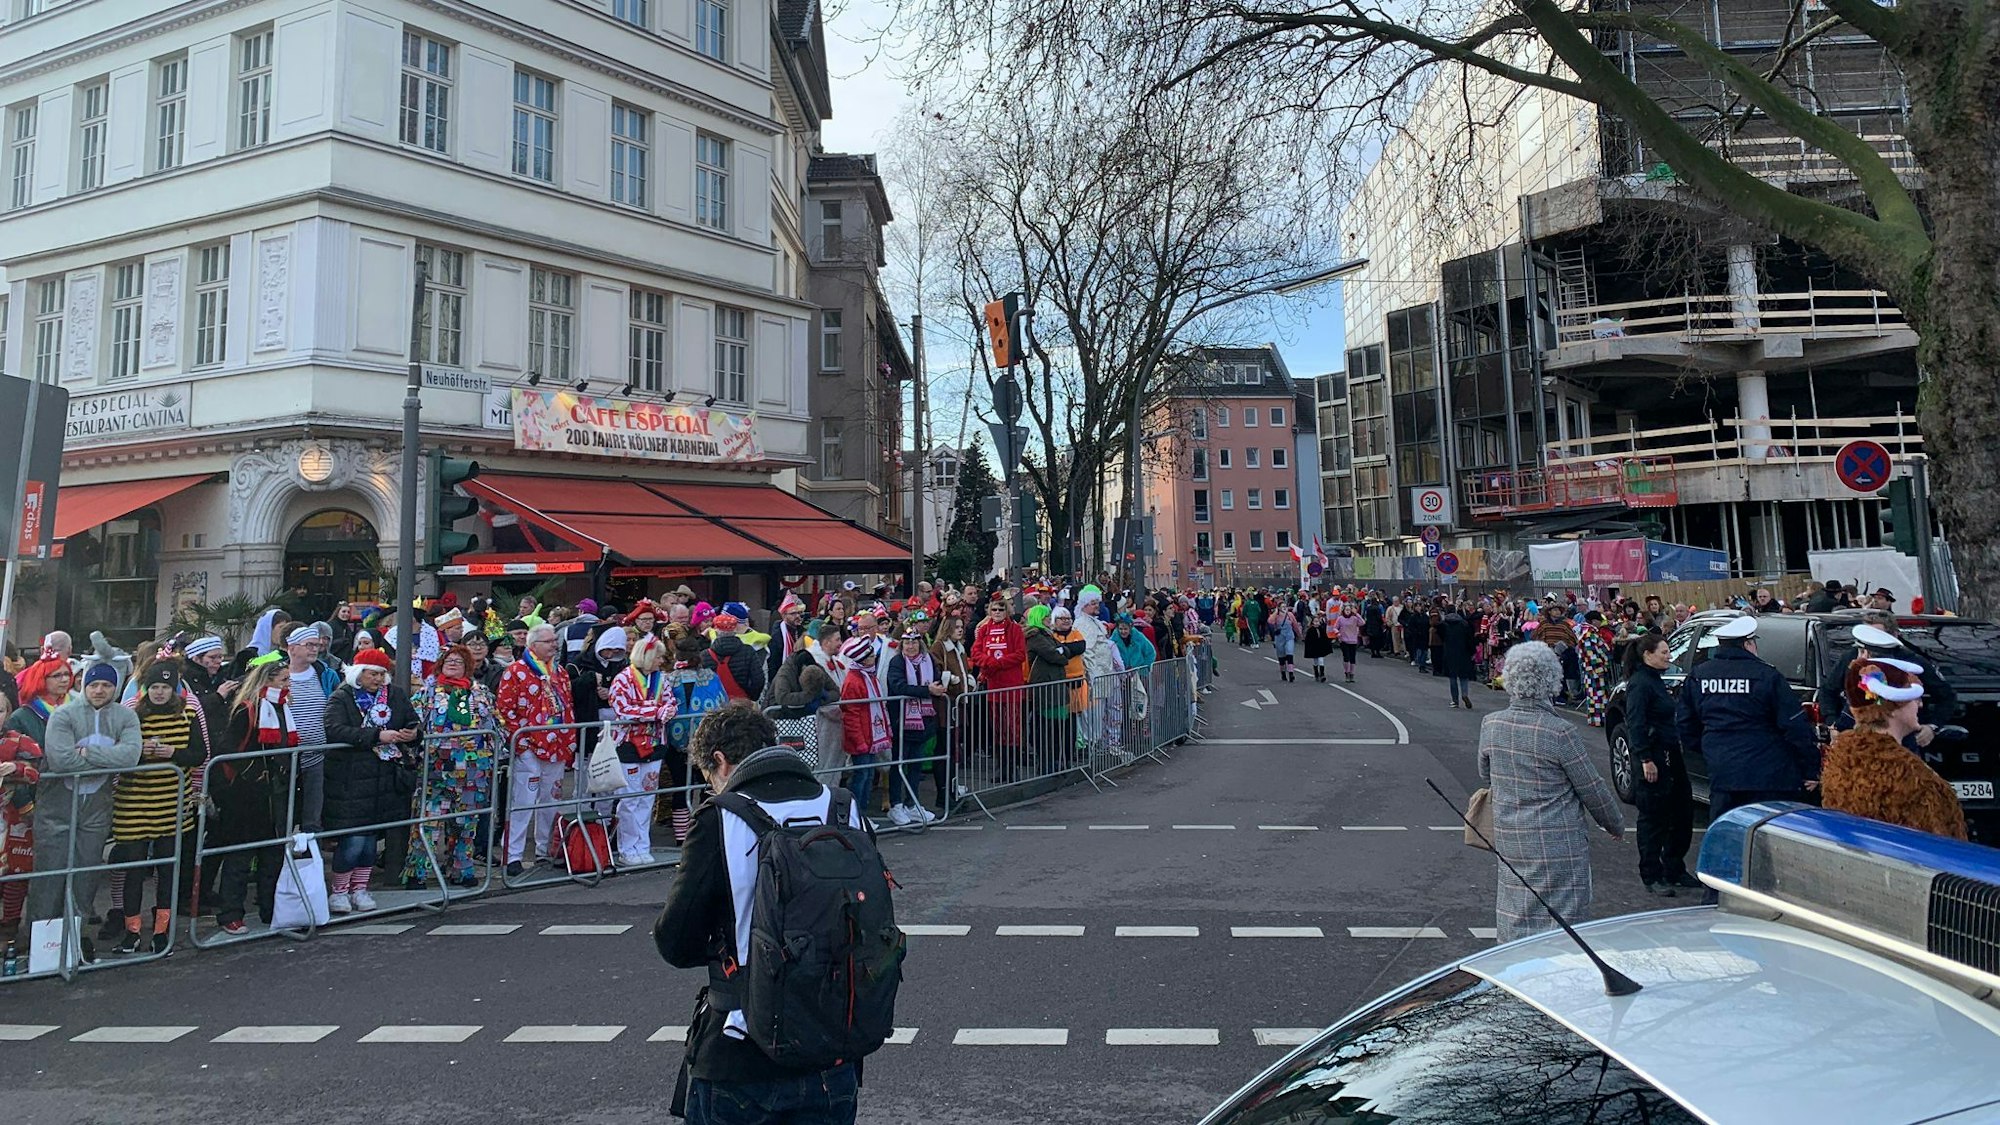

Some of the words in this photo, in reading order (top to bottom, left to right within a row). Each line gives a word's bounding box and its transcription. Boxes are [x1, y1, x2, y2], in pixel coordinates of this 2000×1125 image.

[426, 370, 488, 391] Neuhöfferstr.
[570, 404, 620, 429] CAFE
[625, 411, 713, 436] ESPECIAL
[566, 428, 590, 446] 200
[593, 431, 626, 449] JAHRE
[628, 433, 667, 453] KÖLNER
[670, 439, 721, 456] KARNEVAL
[1425, 497, 1438, 507] 30
[1428, 544, 1437, 556] P
[1701, 679, 1750, 694] POLIZEI
[1962, 783, 1993, 797] 5284
